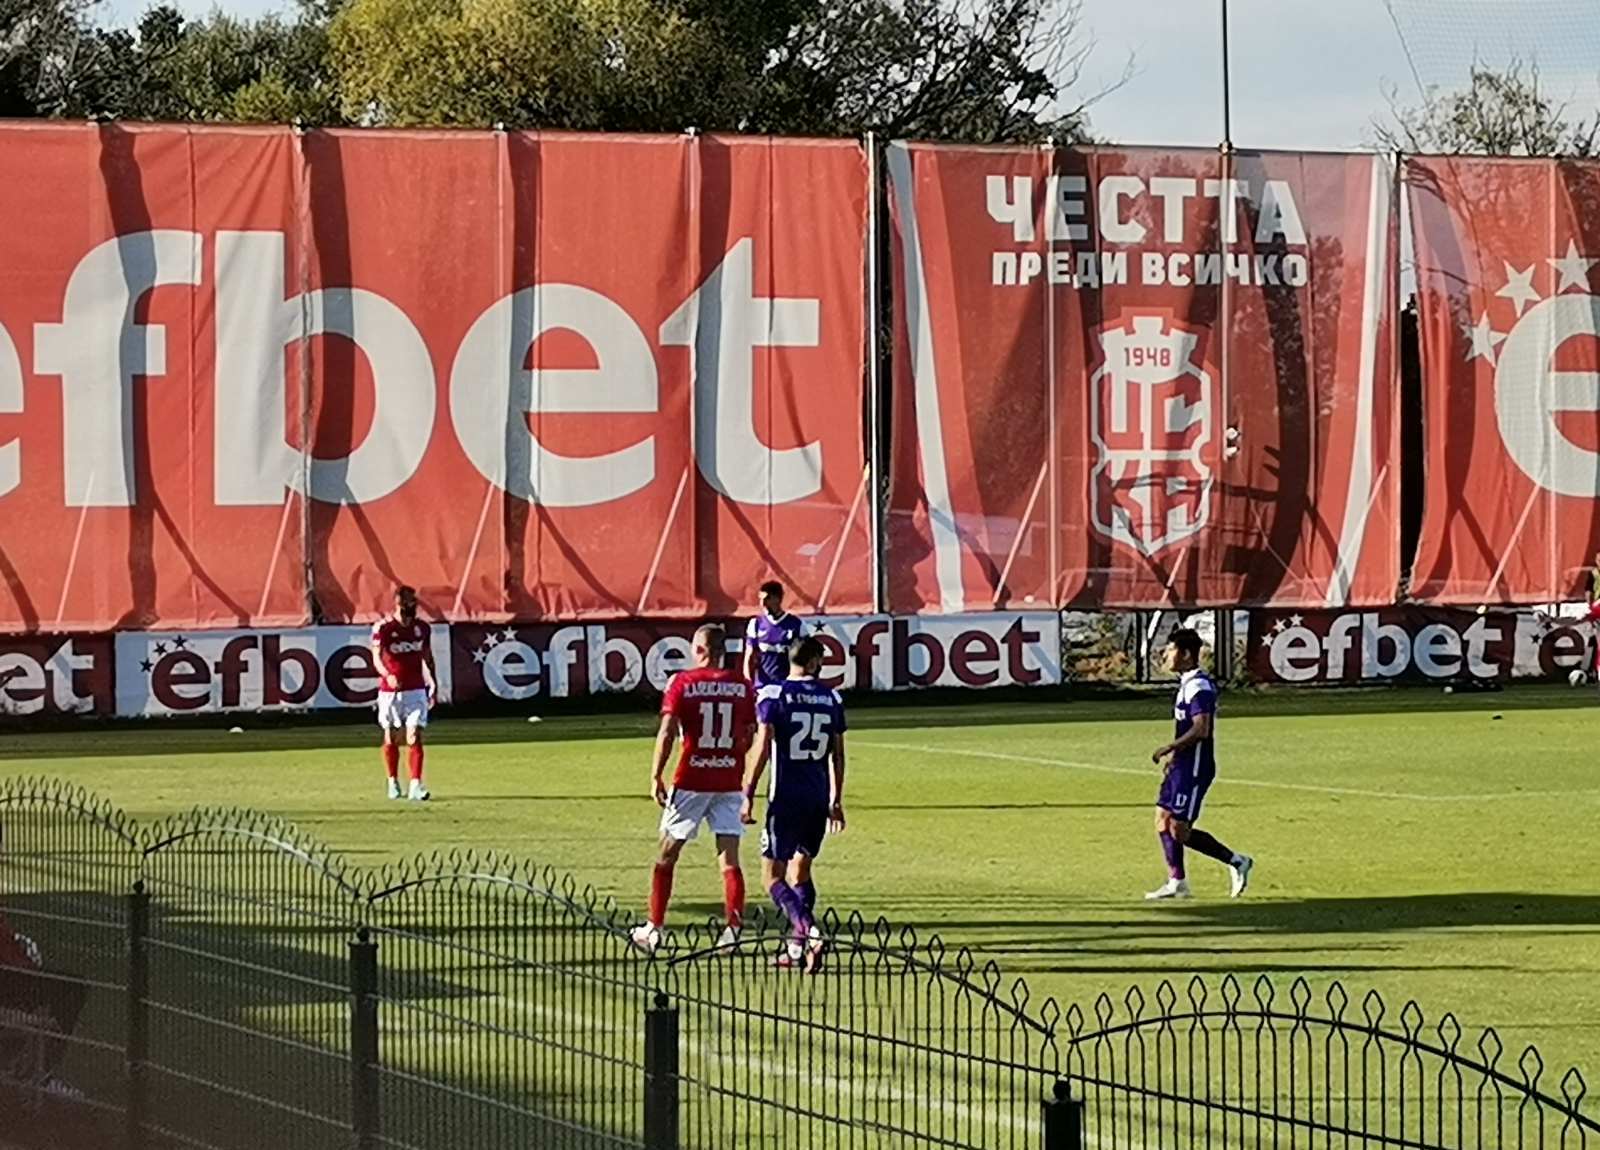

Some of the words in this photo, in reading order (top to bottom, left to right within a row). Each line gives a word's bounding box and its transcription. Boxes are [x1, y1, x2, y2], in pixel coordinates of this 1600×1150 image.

[986, 175, 1307, 245] ЧЕСТТА
[992, 251, 1127, 289] ПРЕДИ
[1141, 252, 1308, 288] ВСИЧКО
[0, 229, 822, 507] fbet
[1124, 347, 1171, 367] 1948
[151, 634, 379, 711] efbe
[482, 624, 744, 700] efbe
[1269, 612, 1502, 682] efbet
[1538, 625, 1592, 680] e
[698, 701, 734, 749] 11
[789, 711, 832, 760] 25
